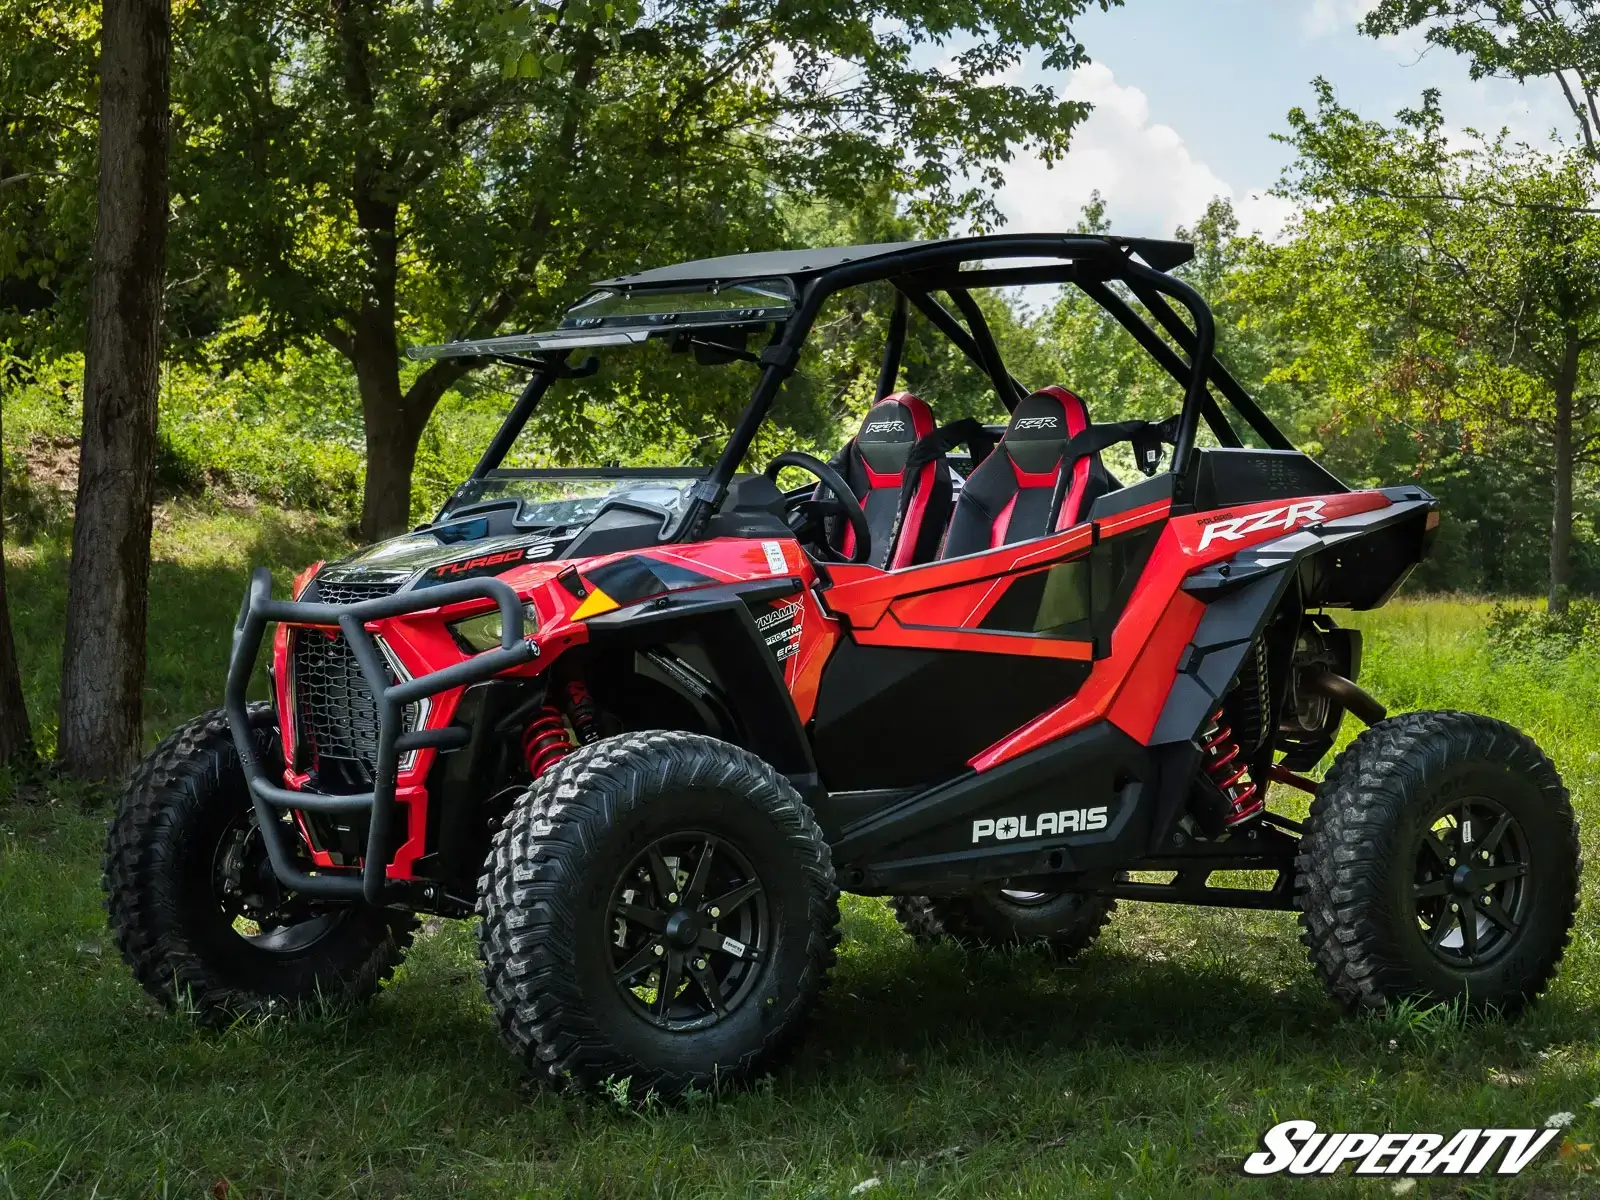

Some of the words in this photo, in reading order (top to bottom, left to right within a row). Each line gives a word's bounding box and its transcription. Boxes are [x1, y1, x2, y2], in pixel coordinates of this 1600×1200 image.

[865, 420, 905, 434] RZR
[1014, 416, 1058, 430] RZR
[1197, 512, 1234, 526] POLARIS
[1198, 499, 1327, 552] RZR
[435, 549, 525, 576] TURBO
[525, 543, 556, 560] S
[764, 624, 802, 646] PROSTAR
[776, 641, 800, 657] EPS
[972, 806, 1108, 843] POLARIS
